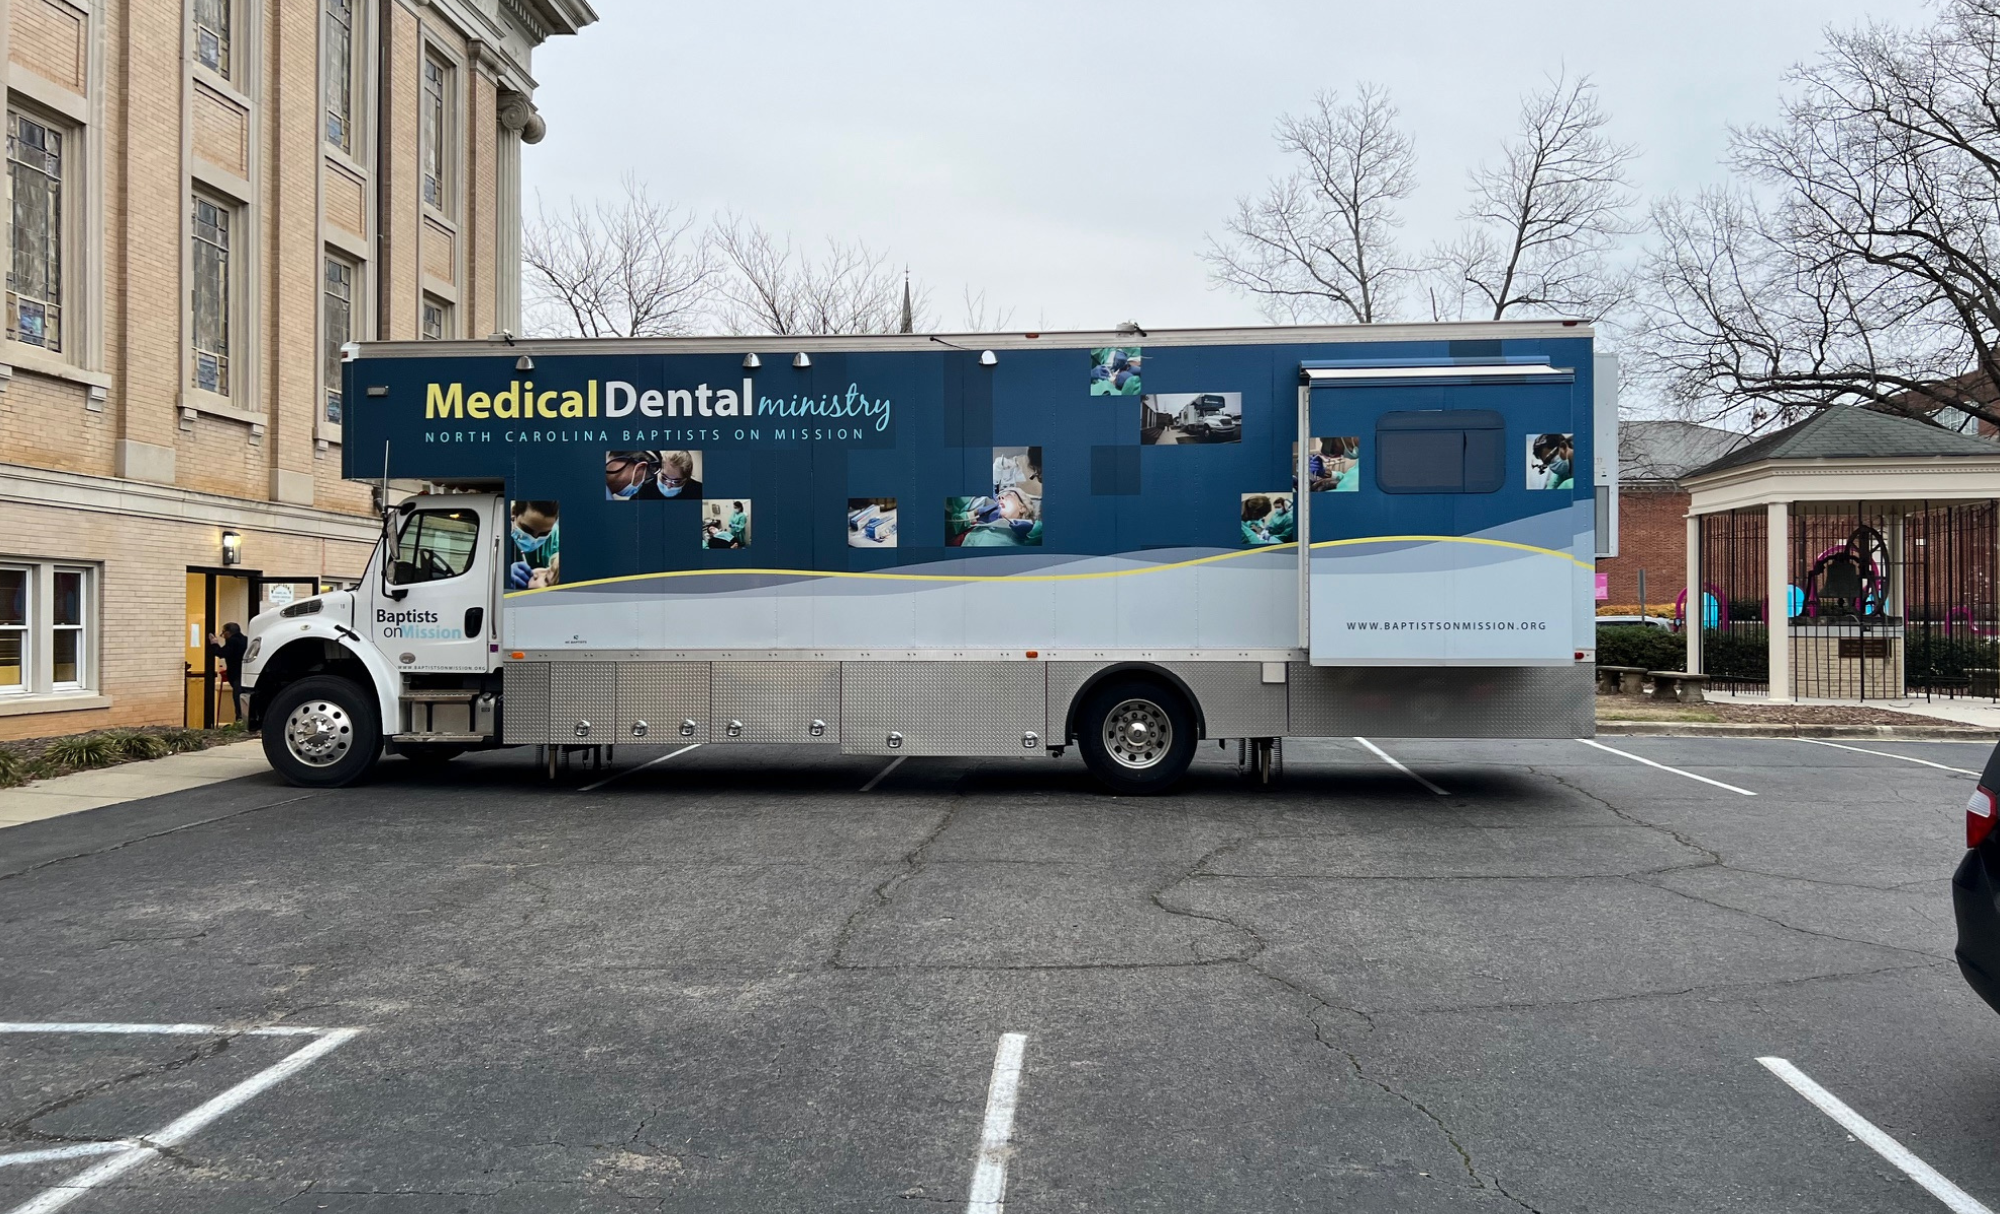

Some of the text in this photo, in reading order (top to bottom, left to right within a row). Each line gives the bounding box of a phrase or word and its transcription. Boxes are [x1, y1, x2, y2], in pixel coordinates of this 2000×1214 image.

[757, 382, 891, 432] ministry
[425, 428, 863, 443] NORTH CAROLINA BAPTISTS ON MISSION
[376, 609, 438, 625] Baptists
[1346, 621, 1546, 631] WWW.BAPTISTSONMISSION.ORG
